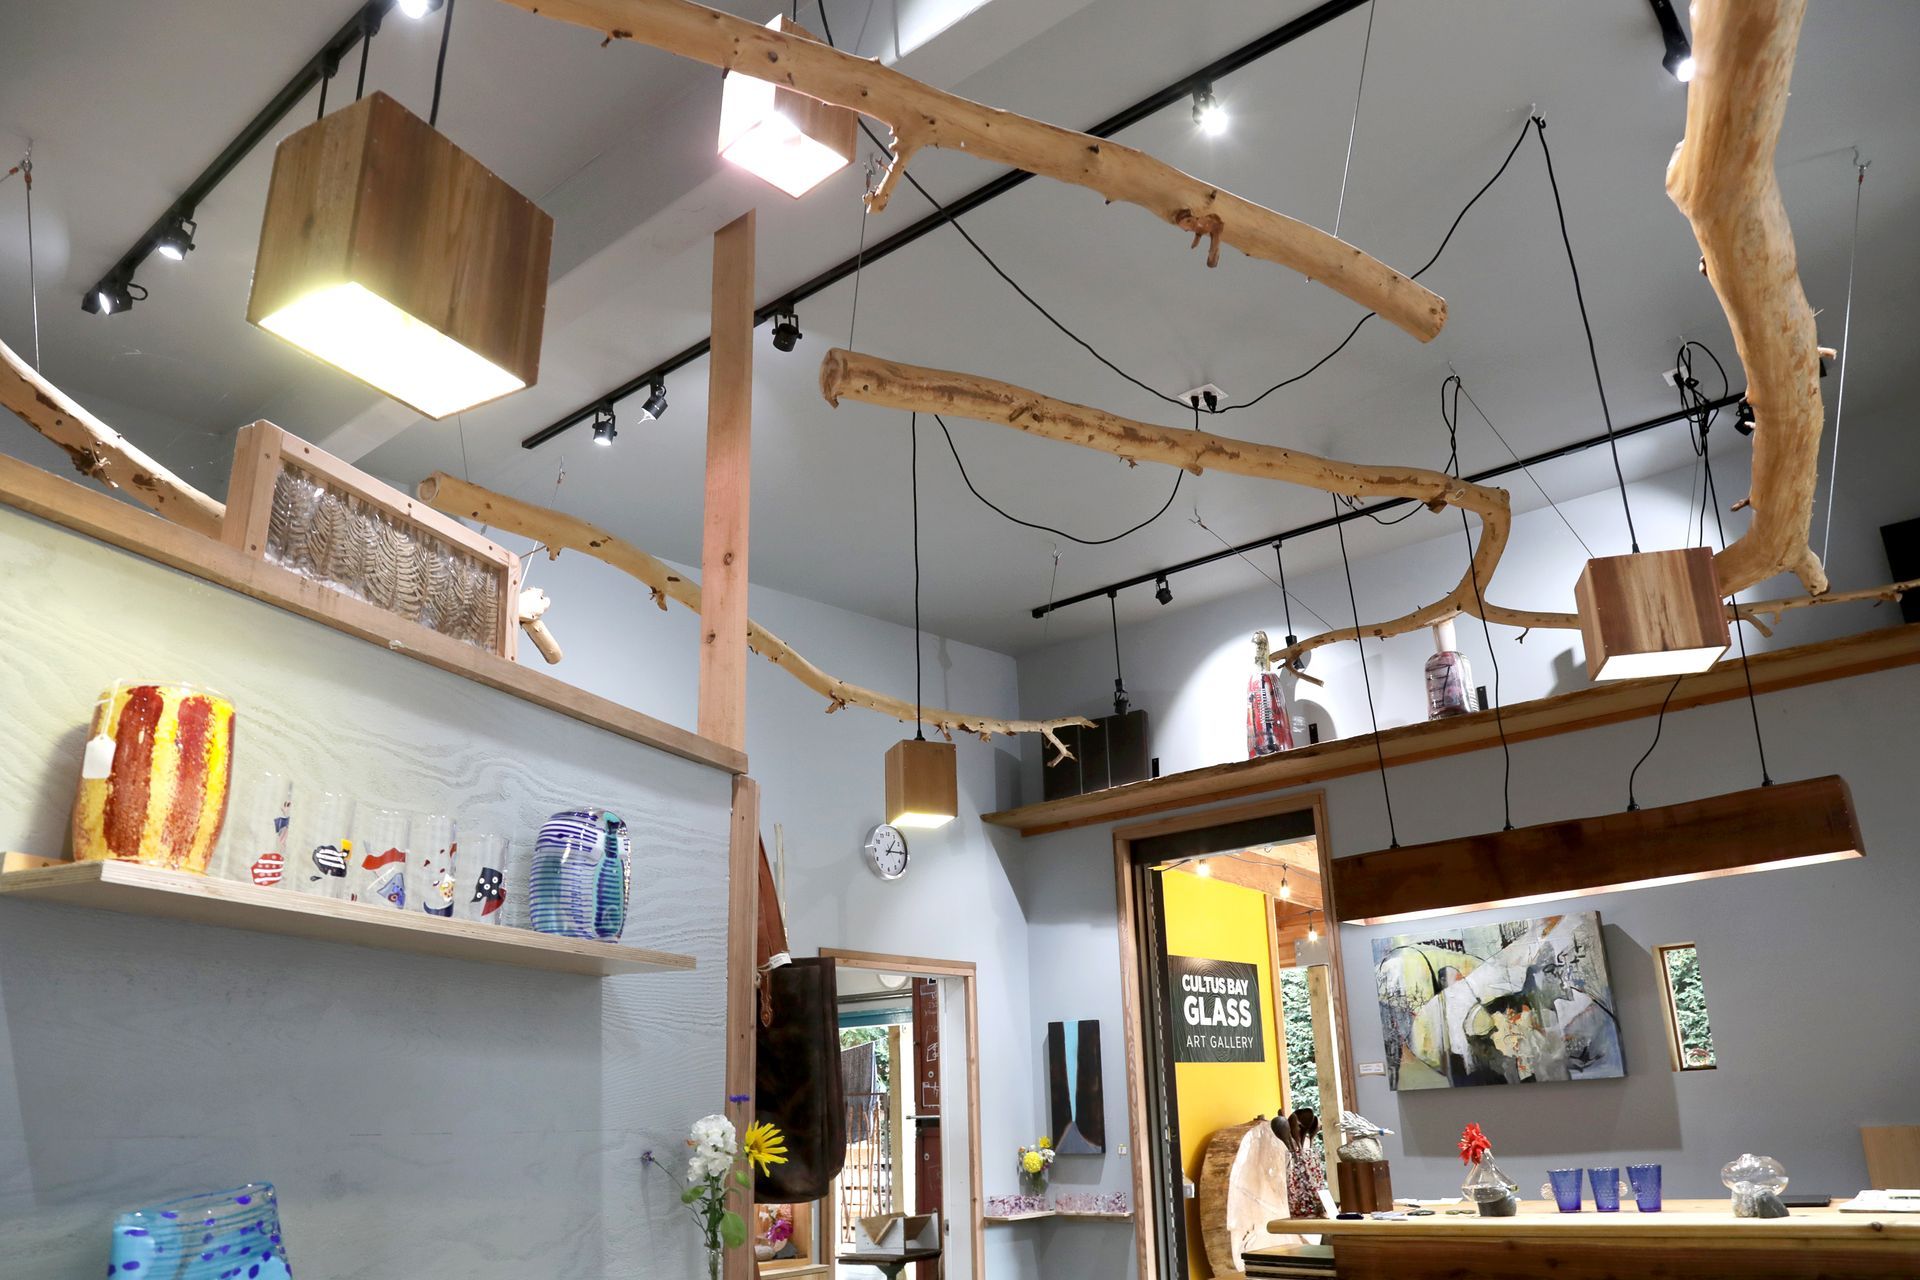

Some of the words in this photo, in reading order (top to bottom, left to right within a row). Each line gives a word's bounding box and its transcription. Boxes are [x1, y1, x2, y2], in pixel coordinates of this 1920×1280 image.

[1182, 974, 1227, 994] CULTUS
[1227, 978, 1249, 995] BAY
[1183, 995, 1252, 1028] GLASS
[1186, 1035, 1206, 1048] ART
[1210, 1035, 1254, 1049] GALLERY
